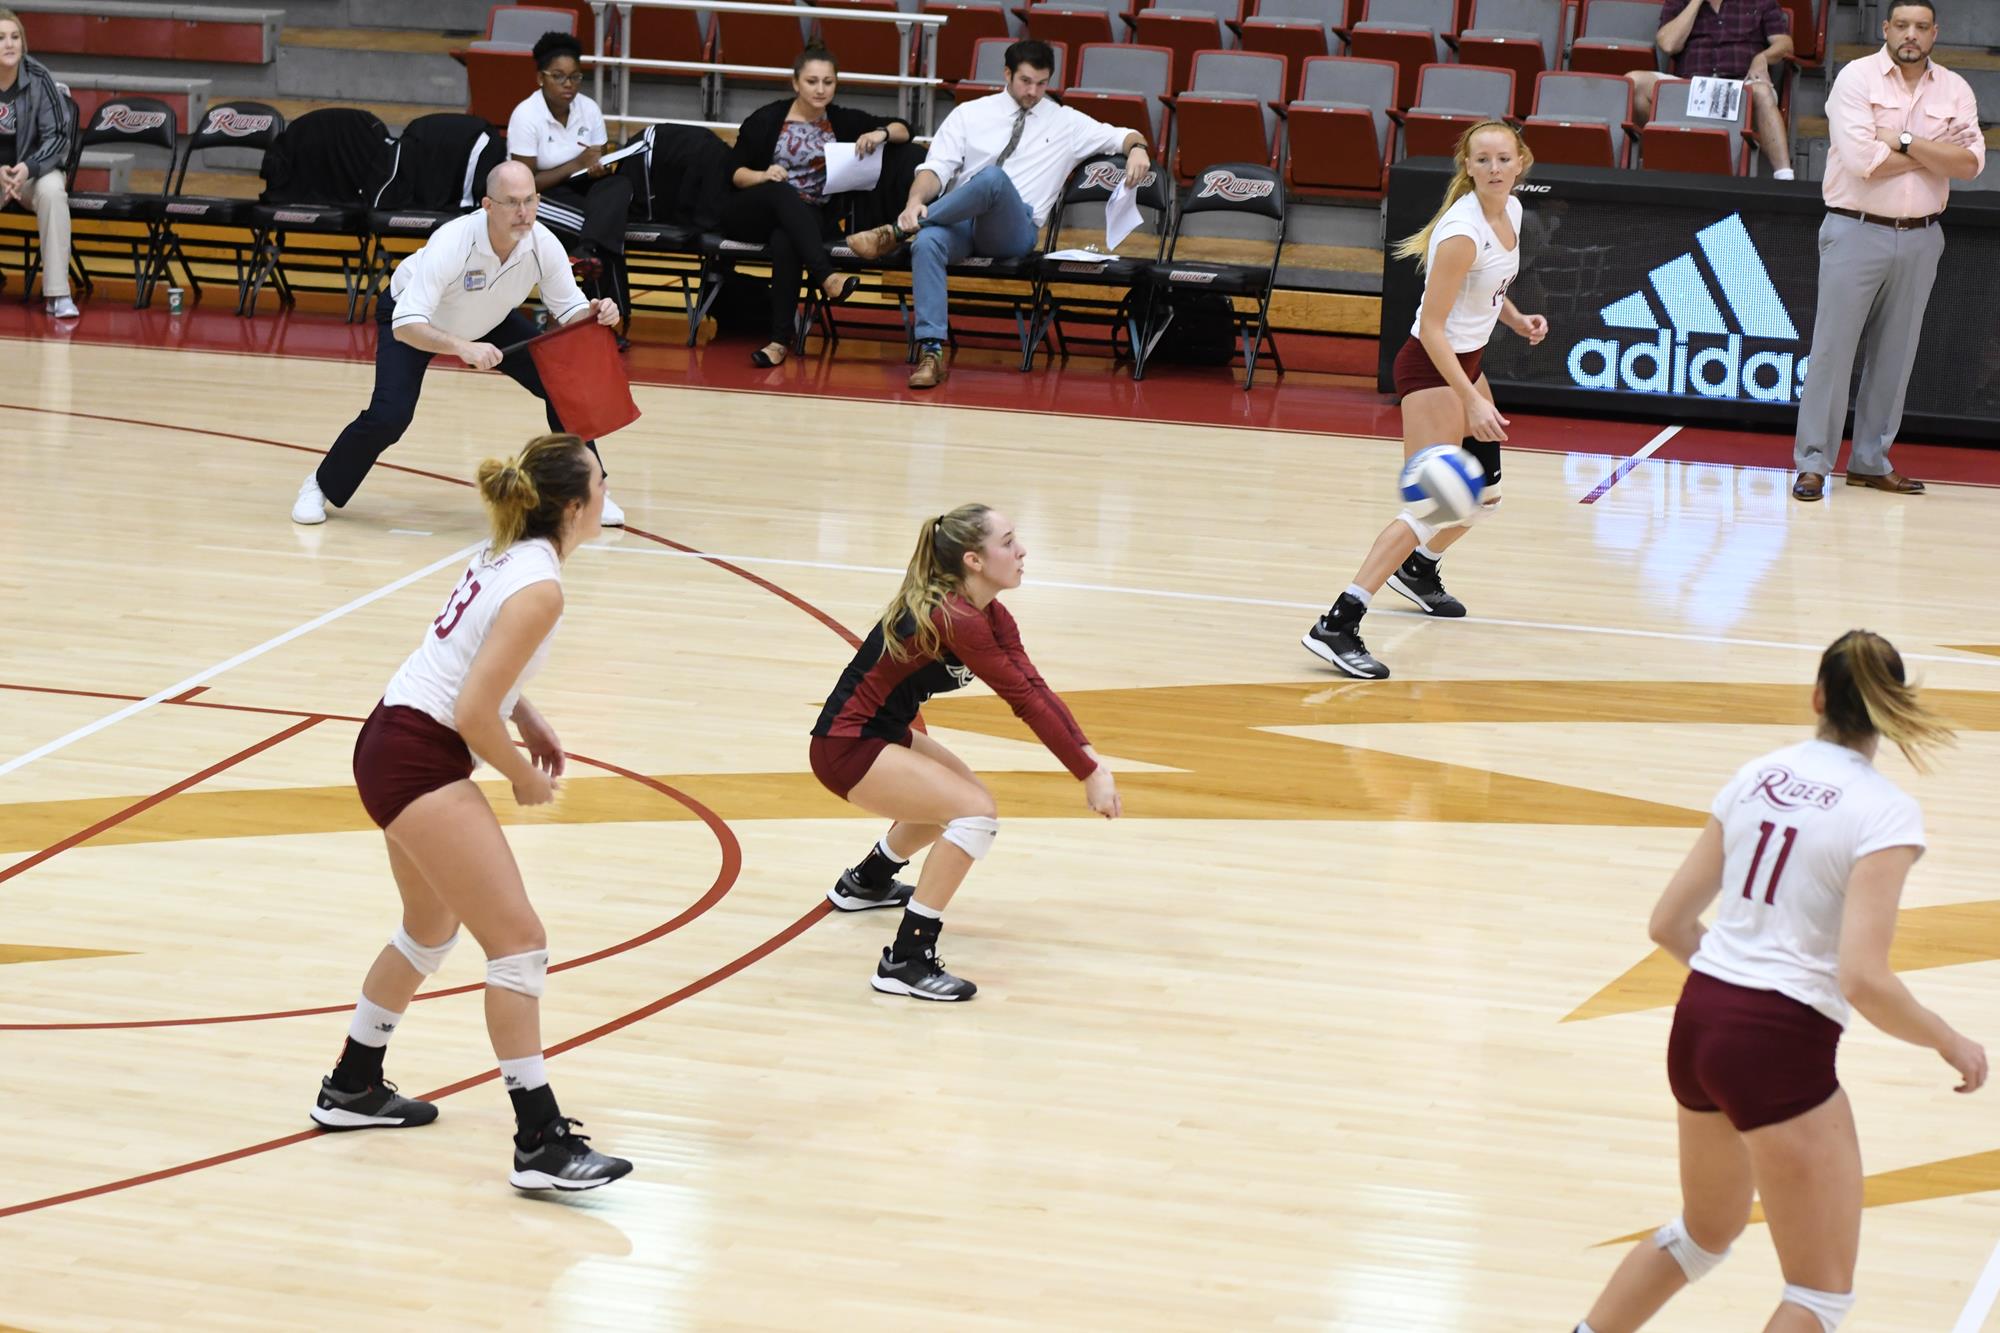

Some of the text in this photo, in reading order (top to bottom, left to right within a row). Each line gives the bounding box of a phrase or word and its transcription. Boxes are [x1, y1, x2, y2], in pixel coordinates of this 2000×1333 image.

[1199, 171, 1273, 200] RIDER
[1512, 183, 1552, 193] ANC
[1749, 767, 1837, 808] RIDER
[1743, 820, 1798, 906] 11
